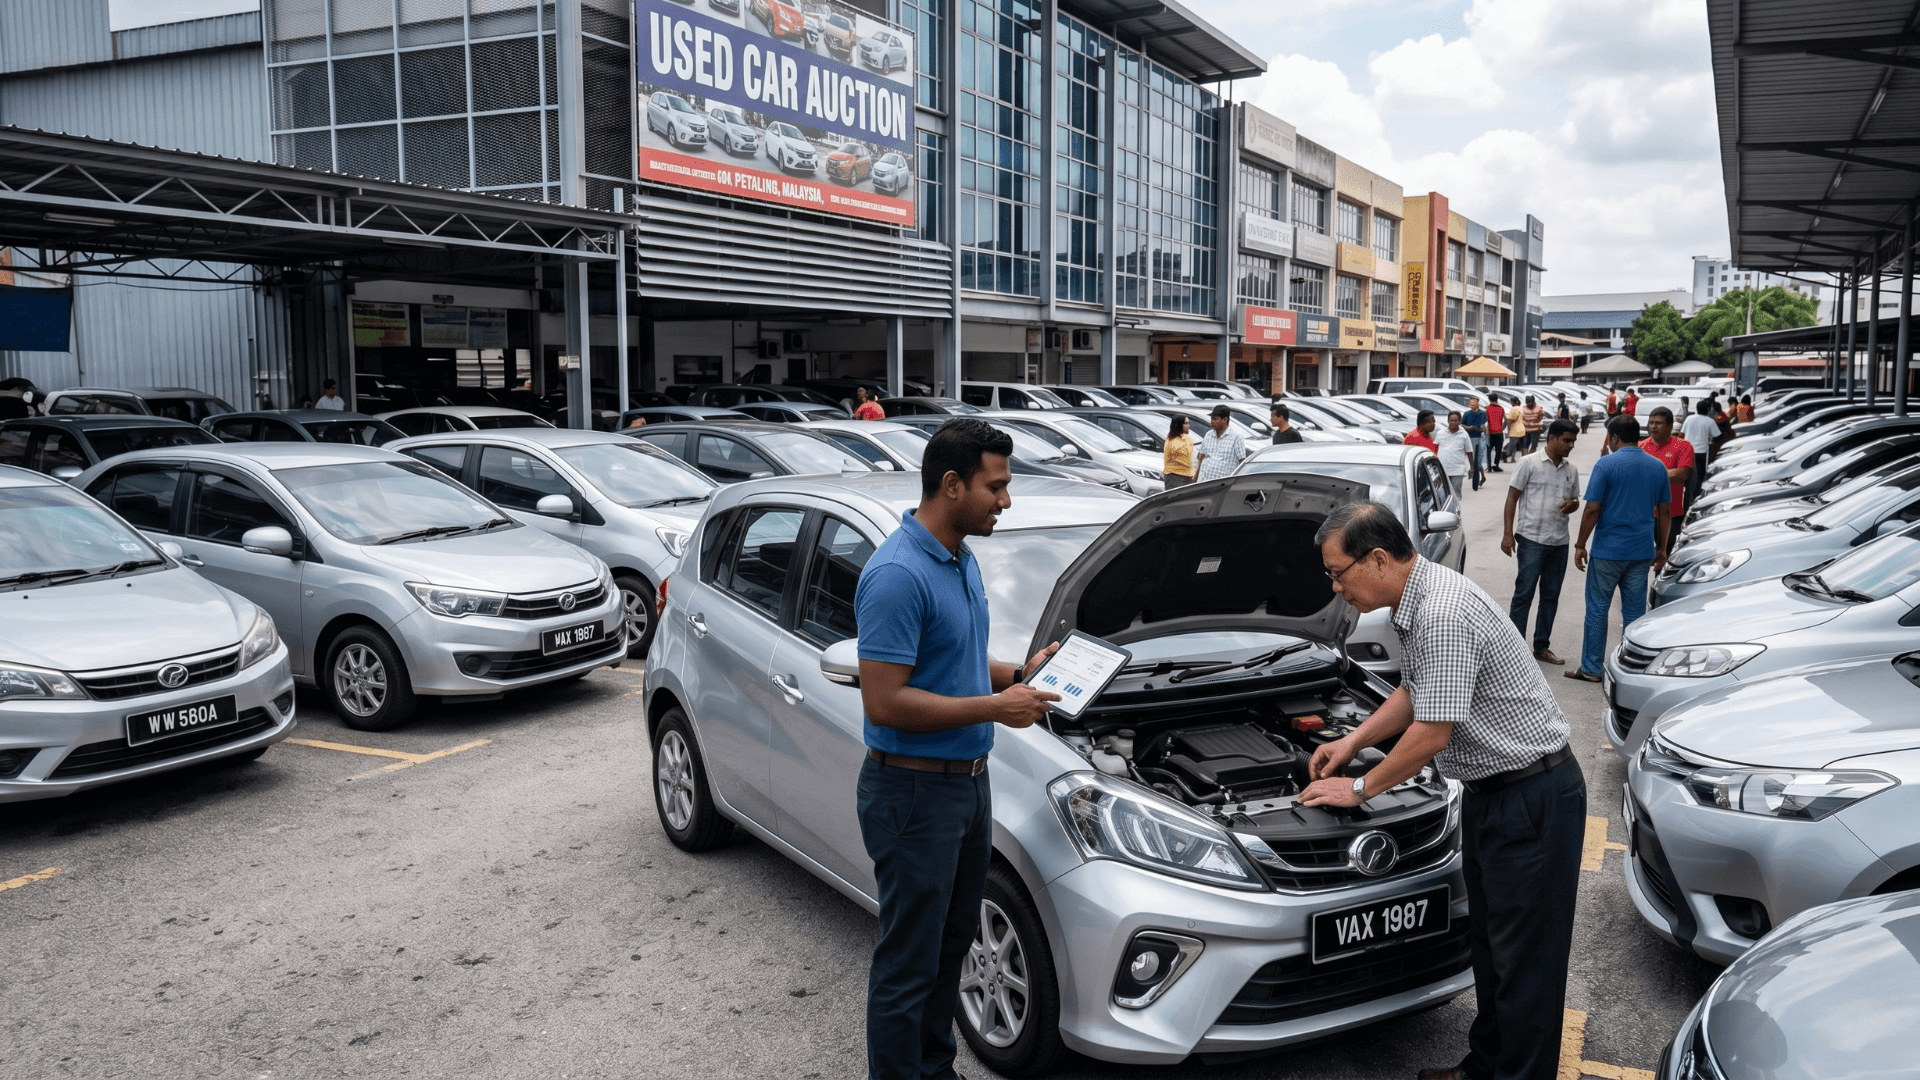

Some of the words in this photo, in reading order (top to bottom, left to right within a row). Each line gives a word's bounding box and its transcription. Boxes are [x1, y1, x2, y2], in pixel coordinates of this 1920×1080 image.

[650, 11, 733, 91] USED
[743, 43, 798, 111] CAR
[805, 64, 906, 141] AUCTION
[735, 172, 781, 197] PETALING,
[782, 181, 824, 205] MALAYSIA,
[179, 703, 218, 727] 580A
[1335, 910, 1374, 946] VAX
[1381, 898, 1428, 935] 1987
